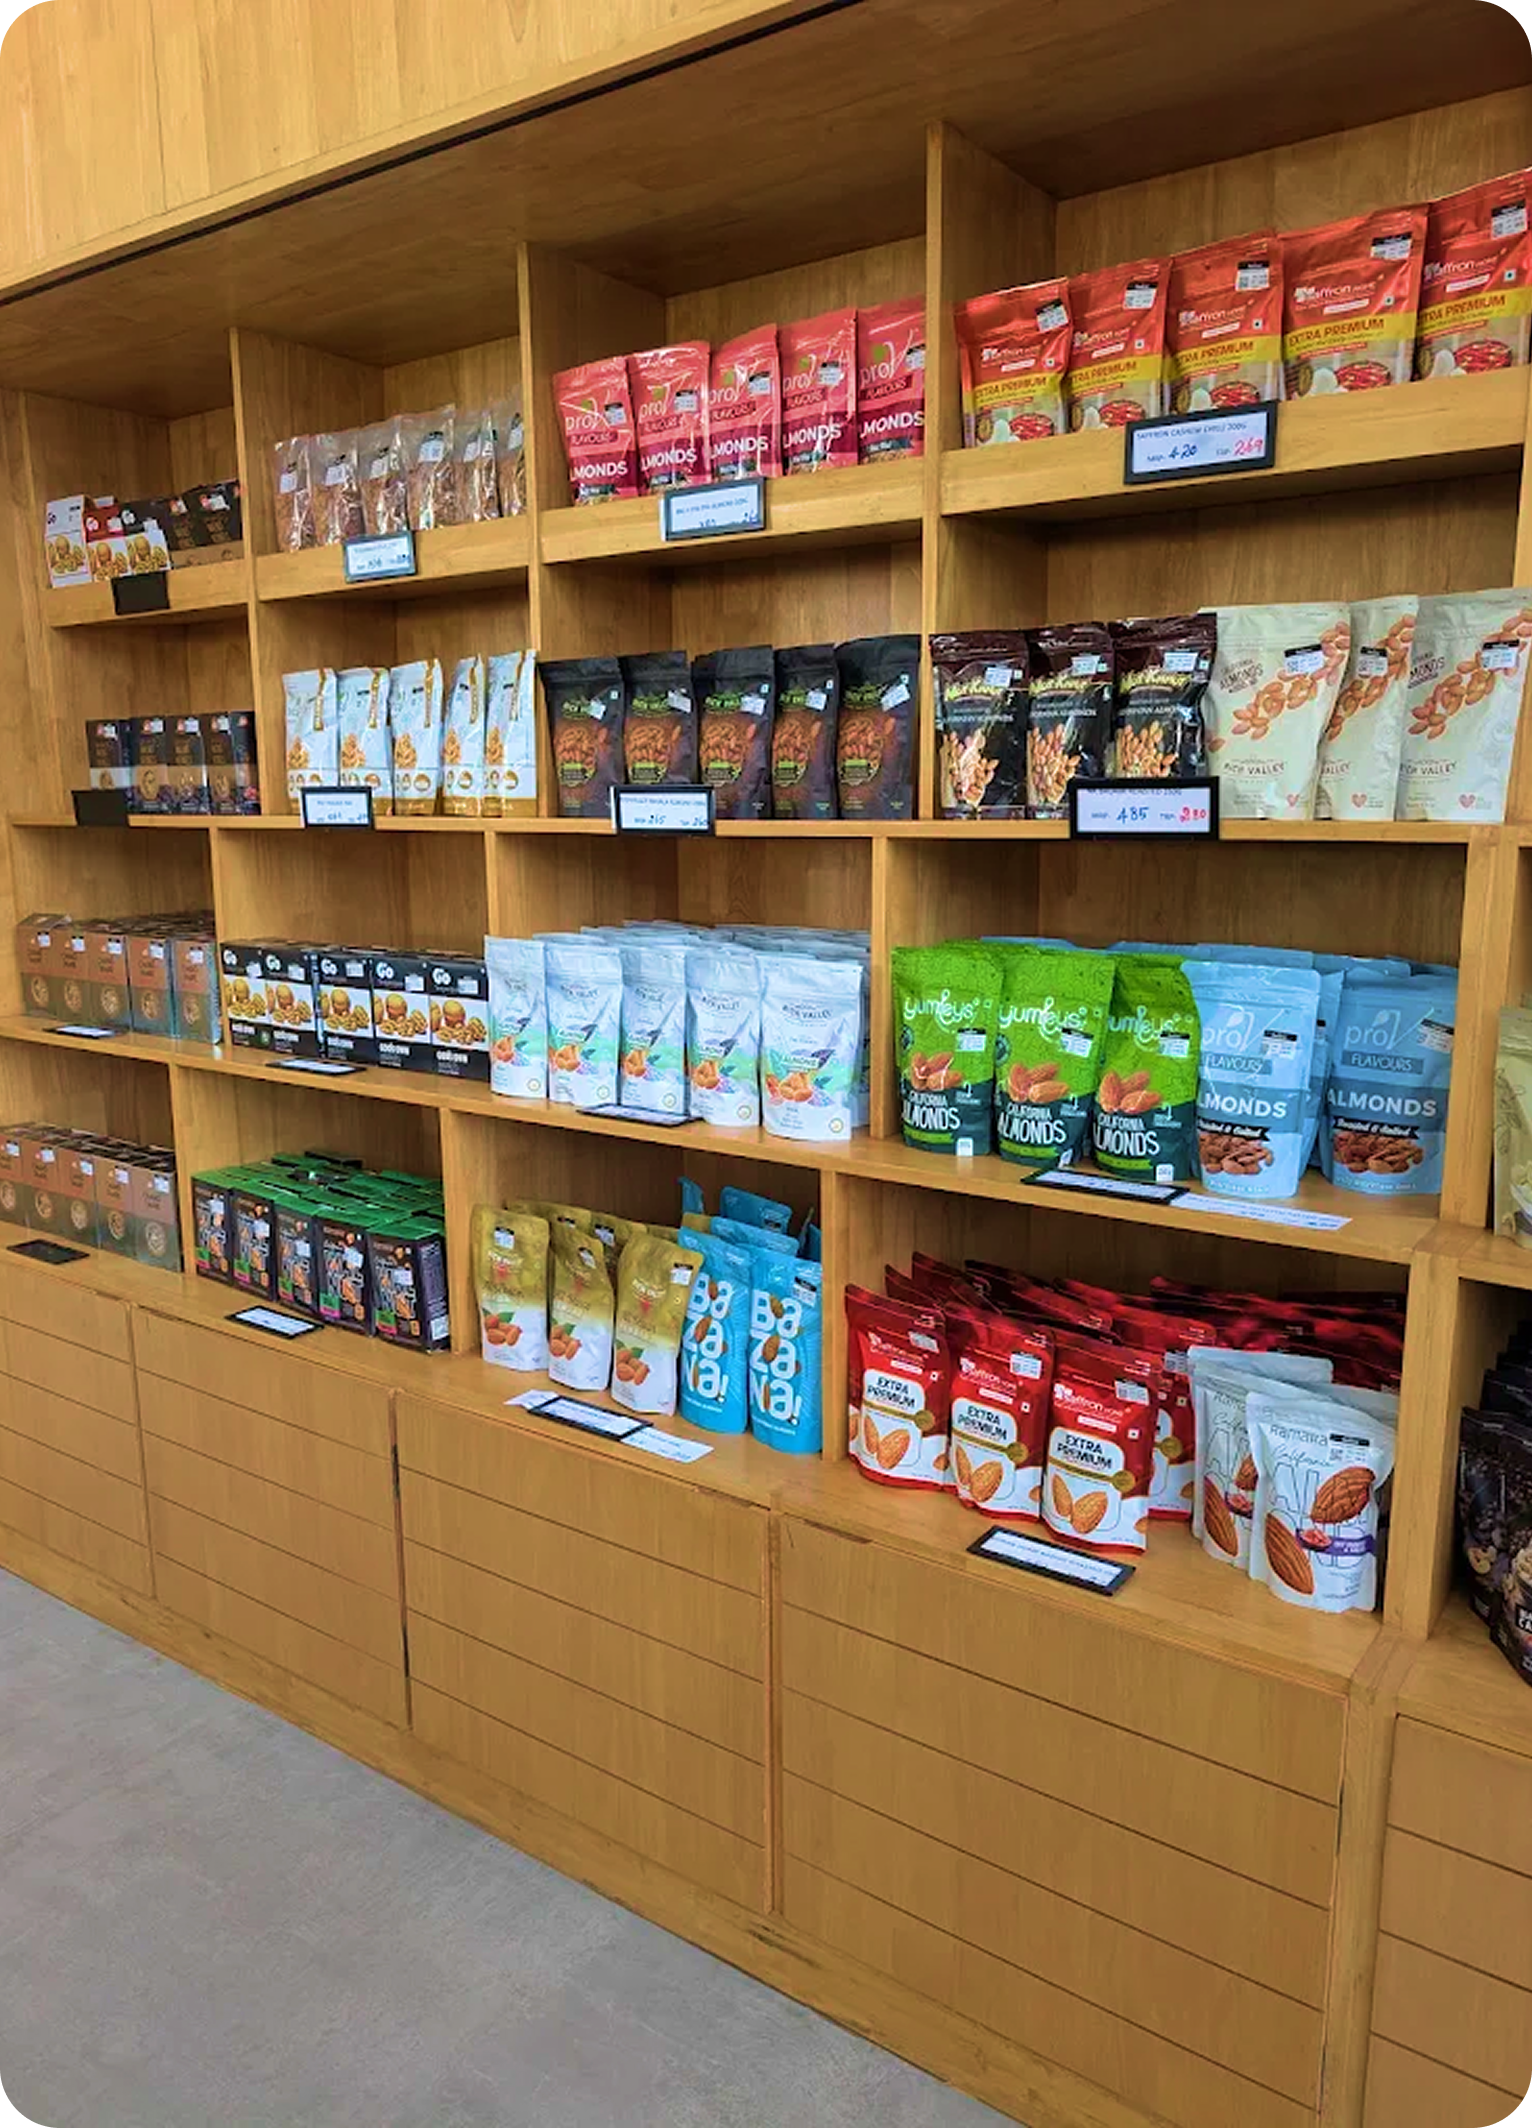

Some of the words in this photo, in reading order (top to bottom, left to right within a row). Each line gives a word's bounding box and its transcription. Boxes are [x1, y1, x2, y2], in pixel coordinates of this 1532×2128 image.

[1324, 318, 1385, 341] PREMIUM
[861, 411, 925, 440] MONDS
[1171, 427, 1201, 438] CASHEW
[711, 436, 769, 461] MONDS
[570, 461, 629, 482] MONDS
[1220, 663, 1265, 690] ALMONDS
[1411, 657, 1446, 677] MONDS
[1248, 761, 1285, 775] VALLEY
[1421, 761, 1456, 775] VALLEY
[1116, 806, 1150, 825] 485
[1351, 1054, 1413, 1072] FLAVOURS
[1199, 1092, 1287, 1119] MONDS
[1326, 1088, 1437, 1118] ALMONDS
[1097, 1113, 1145, 1132] CALIFORNIA
[867, 1384, 916, 1407] PREMIUM
[877, 1376, 909, 1395] EXTRA
[967, 1405, 1000, 1425] EXTRA
[957, 1414, 1007, 1440] PREMIUM
[1066, 1434, 1103, 1454] EXTRA
[1057, 1443, 1112, 1468] PREMIUM
